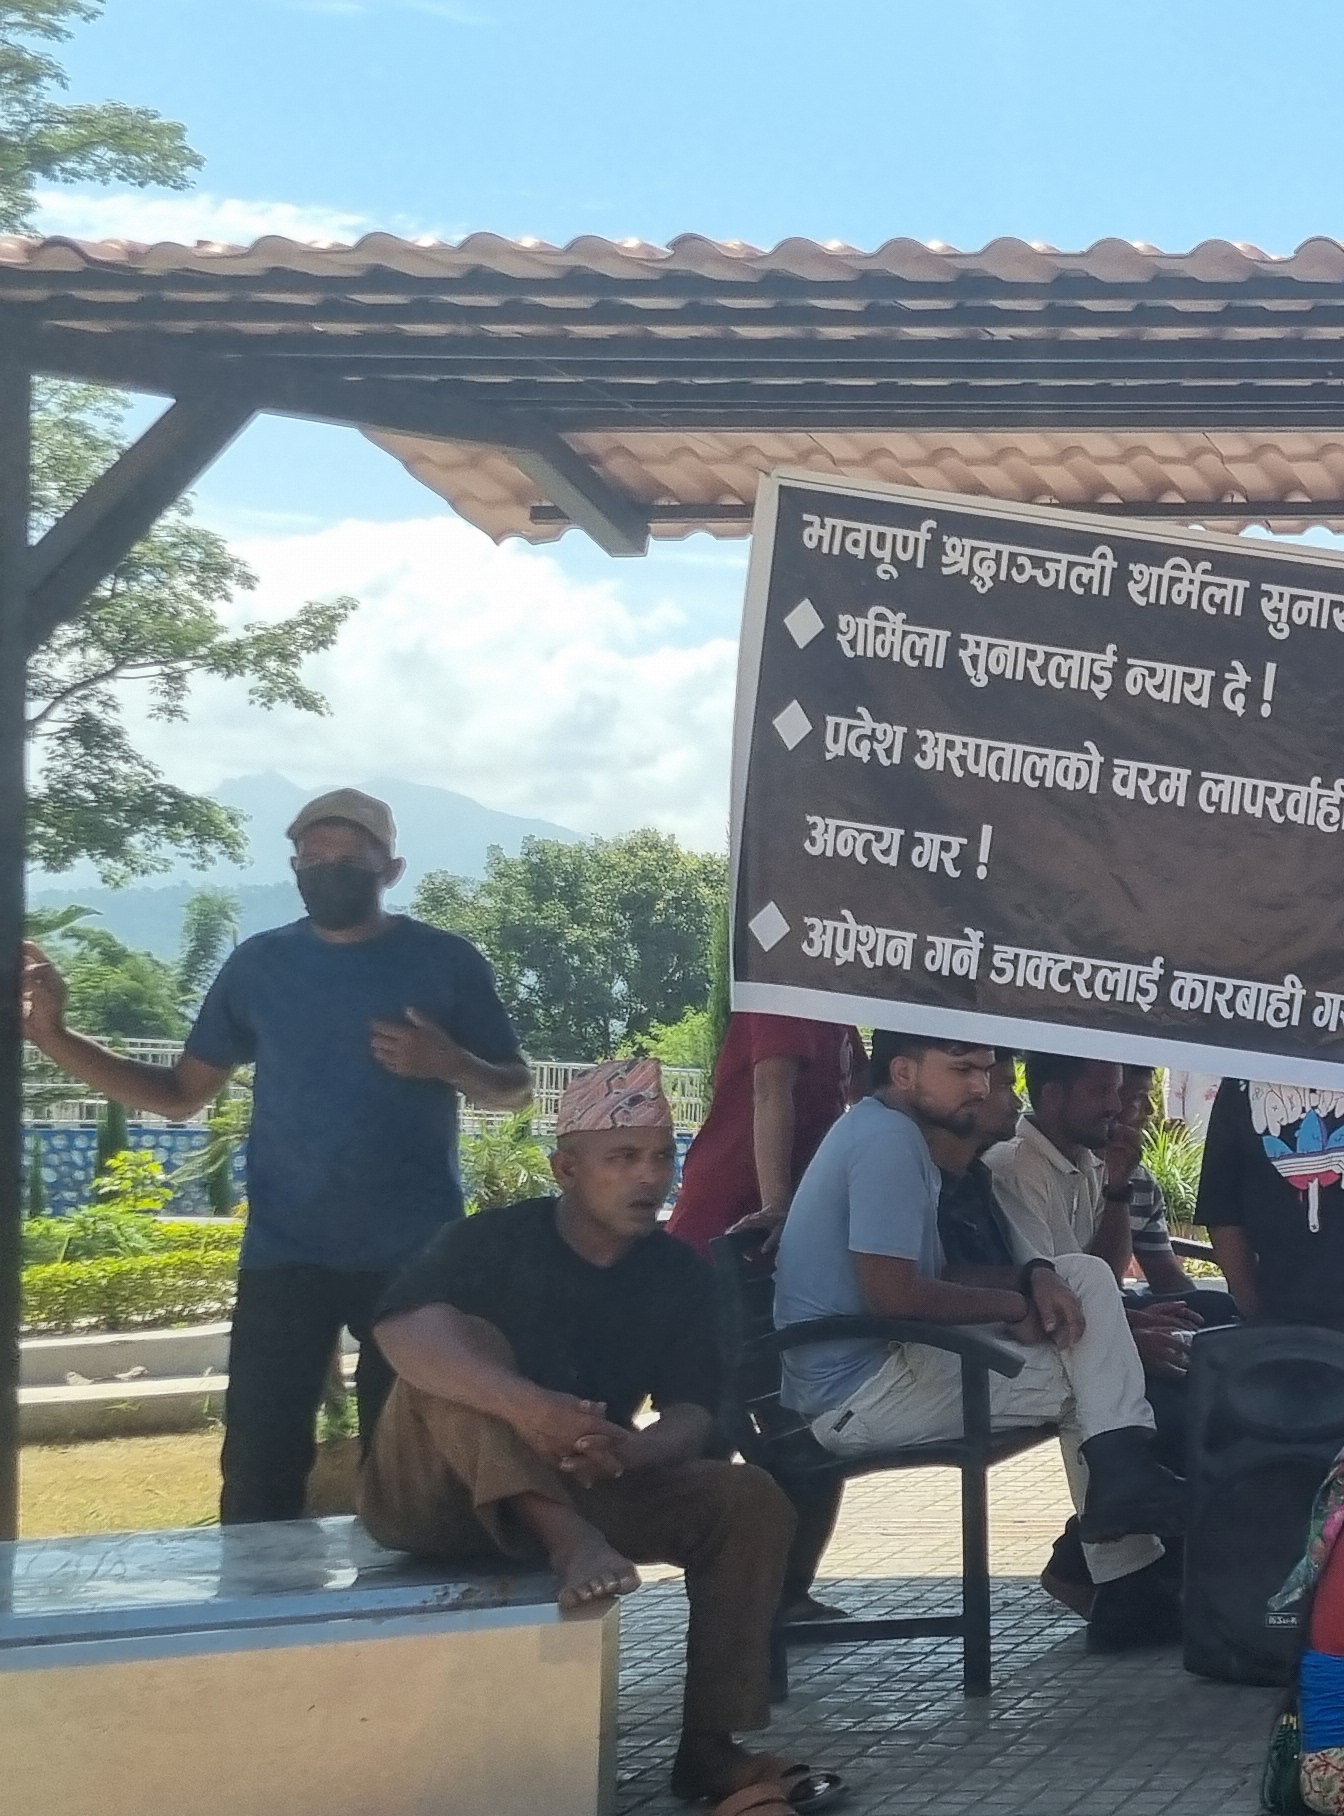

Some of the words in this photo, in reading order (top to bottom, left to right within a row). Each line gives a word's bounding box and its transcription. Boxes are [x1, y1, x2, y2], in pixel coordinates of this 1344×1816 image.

[803, 514, 936, 580] भावपूर्ण
[1128, 557, 1250, 616] शर्मिला
[837, 606, 951, 668] शर्मिला
[959, 633, 1117, 700] सुनारलाई
[1126, 658, 1215, 708] न्याय
[1223, 660, 1251, 717] दे
[1261, 662, 1277, 717] !
[825, 707, 907, 766] प्रदेश
[914, 729, 1104, 794] अस्पतालको
[1112, 759, 1191, 807] चरम
[804, 814, 905, 866] अन्त्य
[911, 832, 967, 877] गर
[977, 824, 992, 879] !
[801, 909, 917, 970] अप्रेशन
[925, 927, 984, 979] गर्ने
[990, 945, 1164, 1012] डाक्टरलाई
[1170, 971, 1306, 1028] कारबाही
